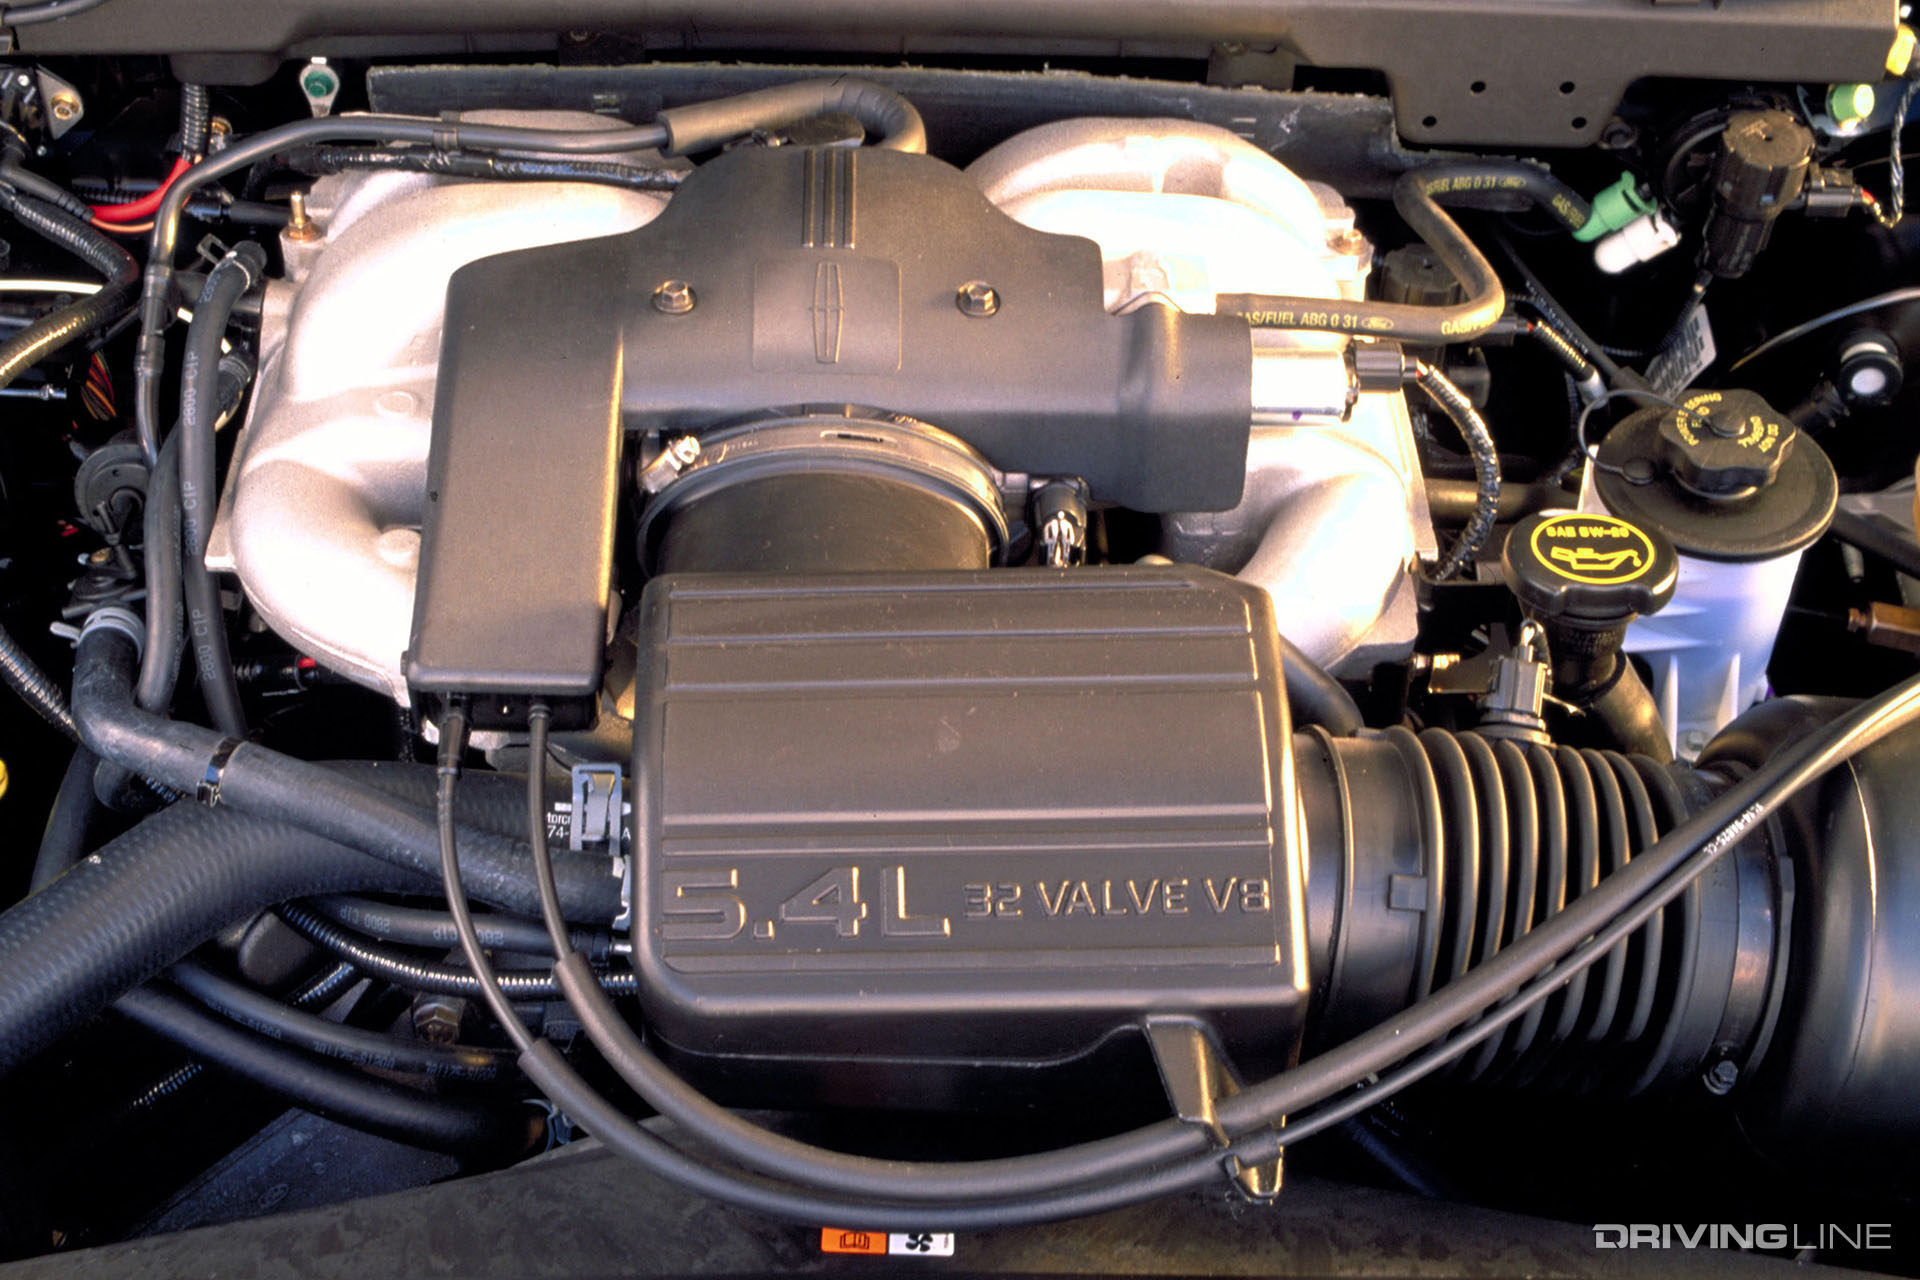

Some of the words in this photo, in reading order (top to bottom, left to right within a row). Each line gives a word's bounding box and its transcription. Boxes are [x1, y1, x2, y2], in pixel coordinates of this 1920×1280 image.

[1483, 175, 1497, 189] 31
[1237, 310, 1297, 327] AS/FUEL
[1300, 312, 1328, 327] ABG
[1342, 314, 1358, 329] 31
[183, 387, 197, 426] 2800
[183, 481, 197, 510] CIP
[184, 518, 199, 556] 2800
[1546, 526, 1576, 538] SAE
[1578, 526, 1630, 538] 5W-20
[192, 608, 208, 637] CIP
[198, 645, 217, 682] 2800
[662, 866, 951, 940] 5.4L
[963, 882, 1023, 918] 32
[1034, 877, 1189, 916] VALVE
[1202, 876, 1271, 914] V8
[364, 913, 391, 934] 2800
[477, 929, 505, 945] 280
